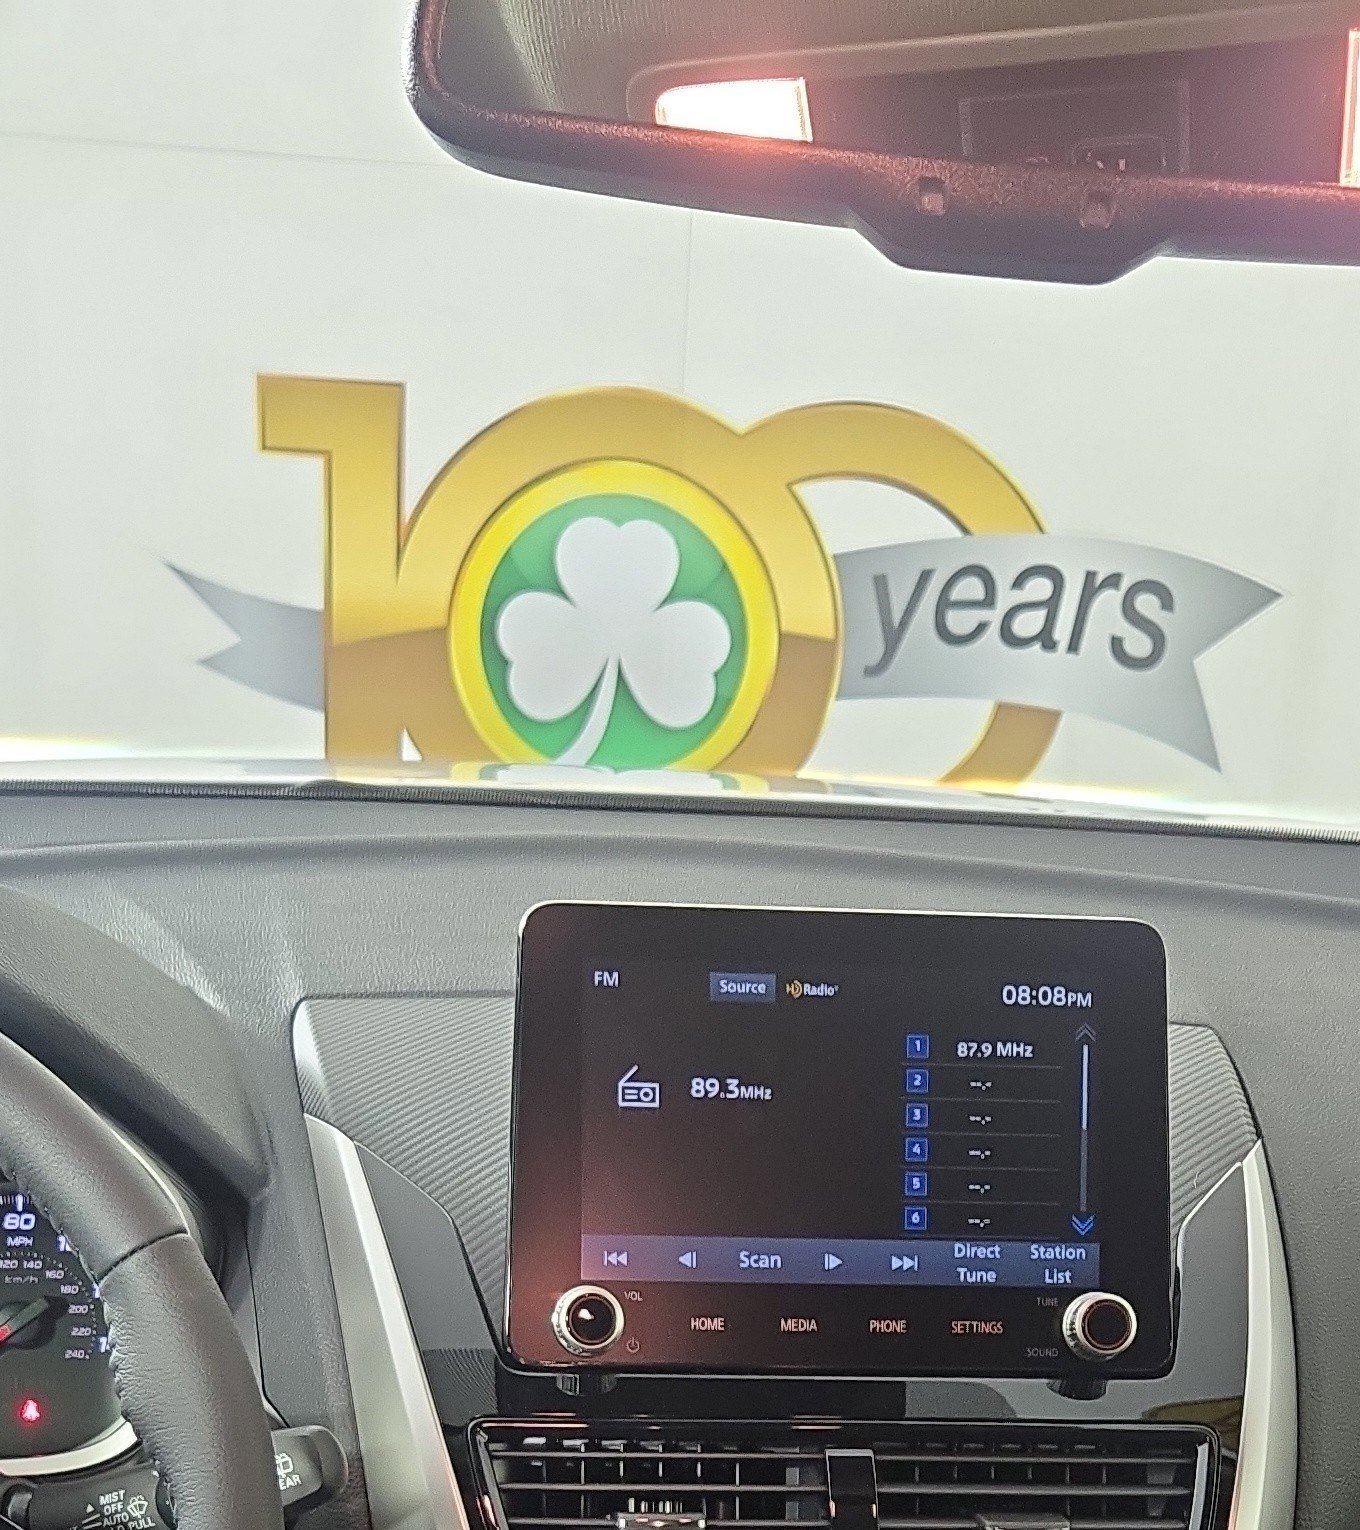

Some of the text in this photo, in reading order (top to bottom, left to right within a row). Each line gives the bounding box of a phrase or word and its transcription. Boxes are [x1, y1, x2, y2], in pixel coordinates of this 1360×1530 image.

[862, 560, 1176, 678] years
[594, 972, 619, 987] FM
[720, 980, 766, 994] Source
[1003, 985, 1091, 1008] 08:08PM
[957, 1042, 1033, 1058] 87.9 MHz
[913, 1074, 922, 1086] 2
[913, 1109, 921, 1121] 3
[912, 1143, 921, 1155] 4
[912, 1178, 921, 1189] 5
[3, 1213, 35, 1230] 80
[911, 1212, 920, 1224] 6
[7, 1236, 33, 1247] MPH
[954, 1243, 1001, 1259] Direct
[1030, 1244, 1086, 1260] Station
[0, 1260, 18, 1269] 120
[22, 1260, 42, 1269] 140
[740, 1251, 782, 1269] Scan
[45, 1270, 64, 1280] 160
[957, 1267, 997, 1283] Tune
[1044, 1268, 1072, 1284] List
[60, 1284, 79, 1295] 180
[624, 1291, 643, 1301] VOL
[1037, 1297, 1058, 1307] TUNE
[68, 1304, 88, 1314] 200
[691, 1317, 725, 1331] HOME
[780, 1318, 818, 1332] MEDIA
[869, 1319, 907, 1333] PHONE
[951, 1321, 1004, 1334] SETTINGS
[71, 1327, 91, 1336] 220
[64, 1350, 85, 1359] 240
[278, 1474, 302, 1490] EAR
[99, 1489, 125, 1505] MIST
[103, 1502, 124, 1515] OFF
[102, 1512, 129, 1527] AUTO
